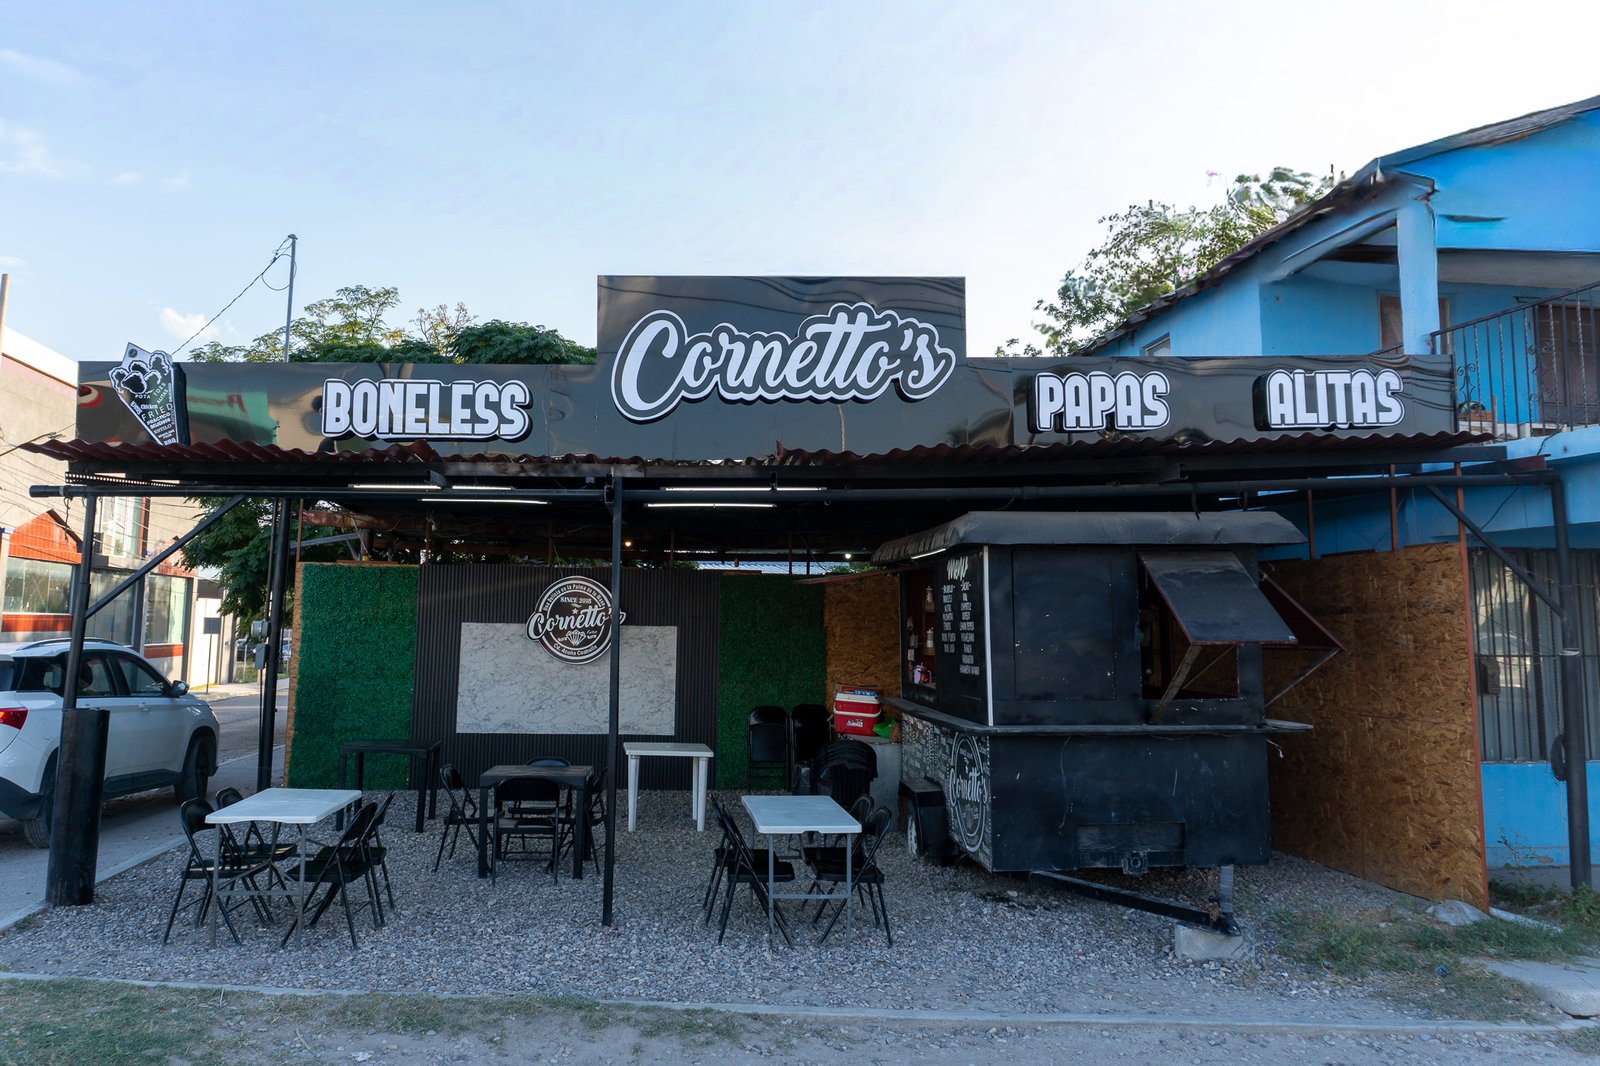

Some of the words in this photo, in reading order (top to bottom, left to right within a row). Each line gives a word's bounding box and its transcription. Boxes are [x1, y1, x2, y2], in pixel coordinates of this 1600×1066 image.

[616, 303, 950, 420] Cornetto's
[141, 403, 173, 421] FRIED
[325, 380, 531, 438] BONELESS
[1036, 371, 1169, 431] PAPAS
[1267, 369, 1404, 429] ALITAS
[560, 596, 578, 604] SINCE
